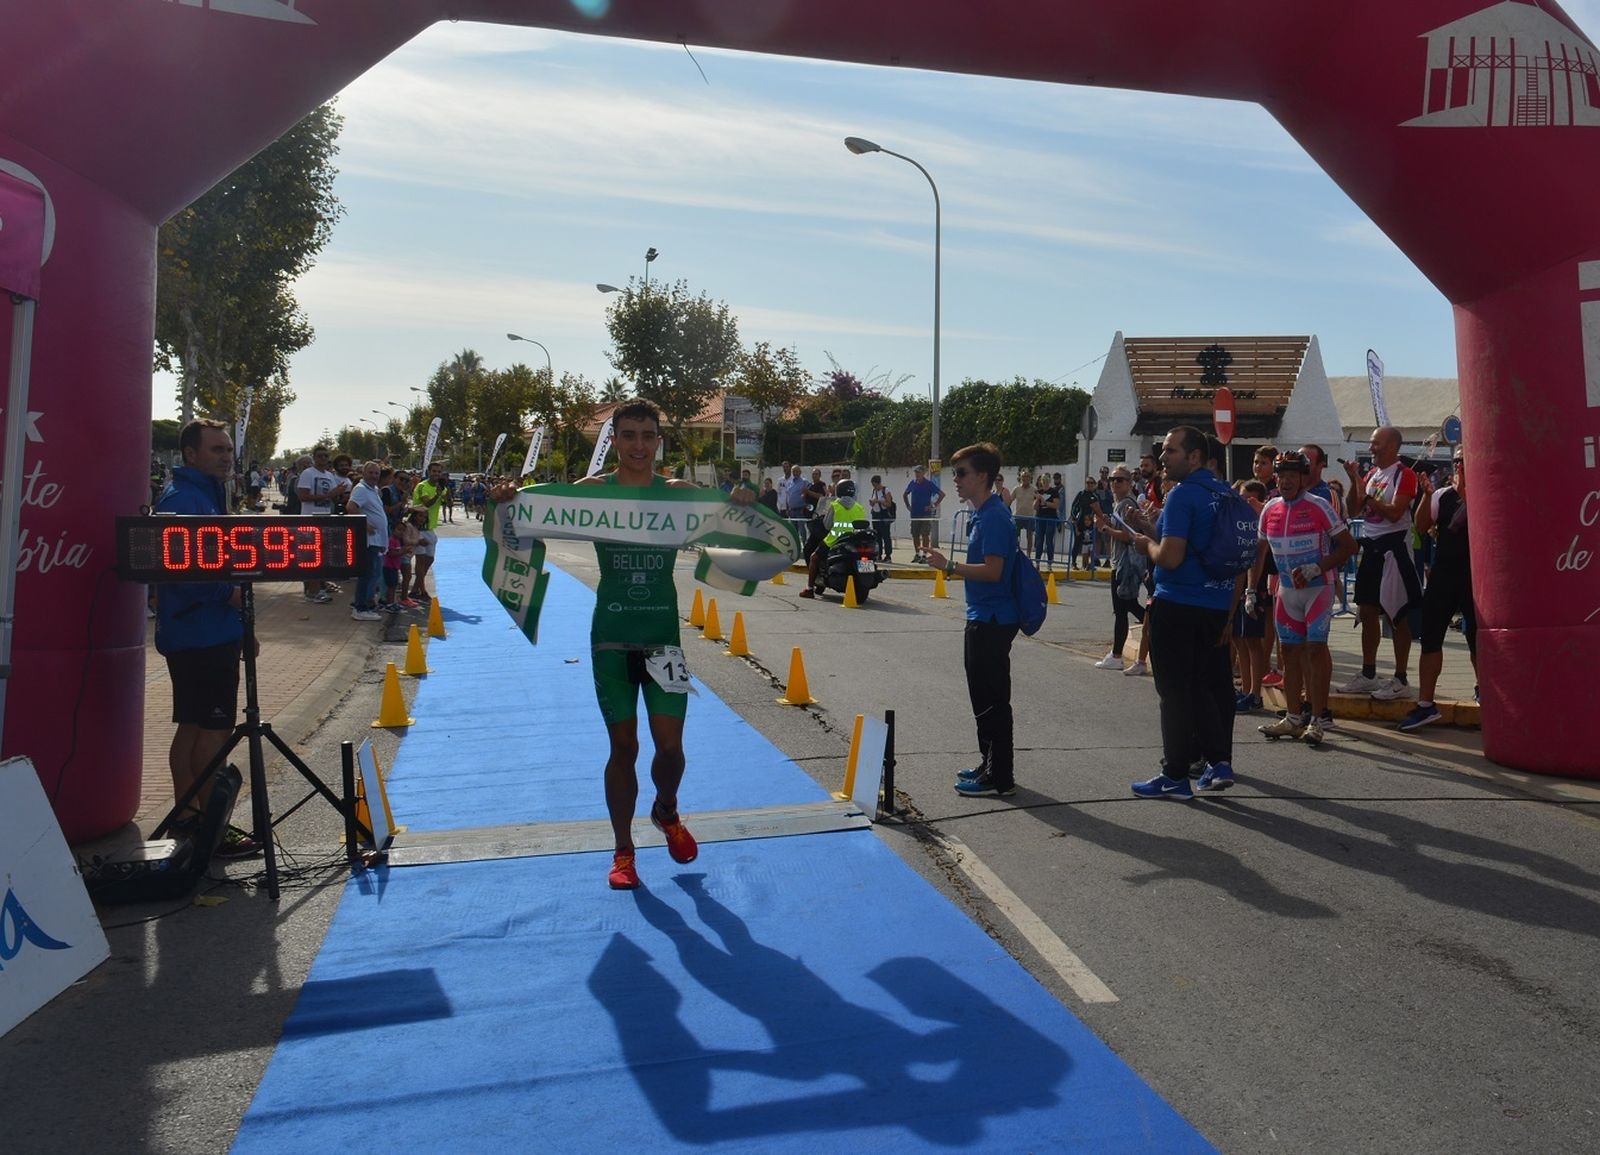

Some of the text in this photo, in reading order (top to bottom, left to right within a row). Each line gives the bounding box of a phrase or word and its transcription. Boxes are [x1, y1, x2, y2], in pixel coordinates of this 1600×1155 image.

[16, 528, 94, 574] bría
[162, 526, 354, 570] 00:59:31
[542, 507, 676, 531] ANDALUZA
[722, 507, 795, 562] RIATLON
[1556, 535, 1594, 572] de
[613, 554, 664, 570] BELLIDO
